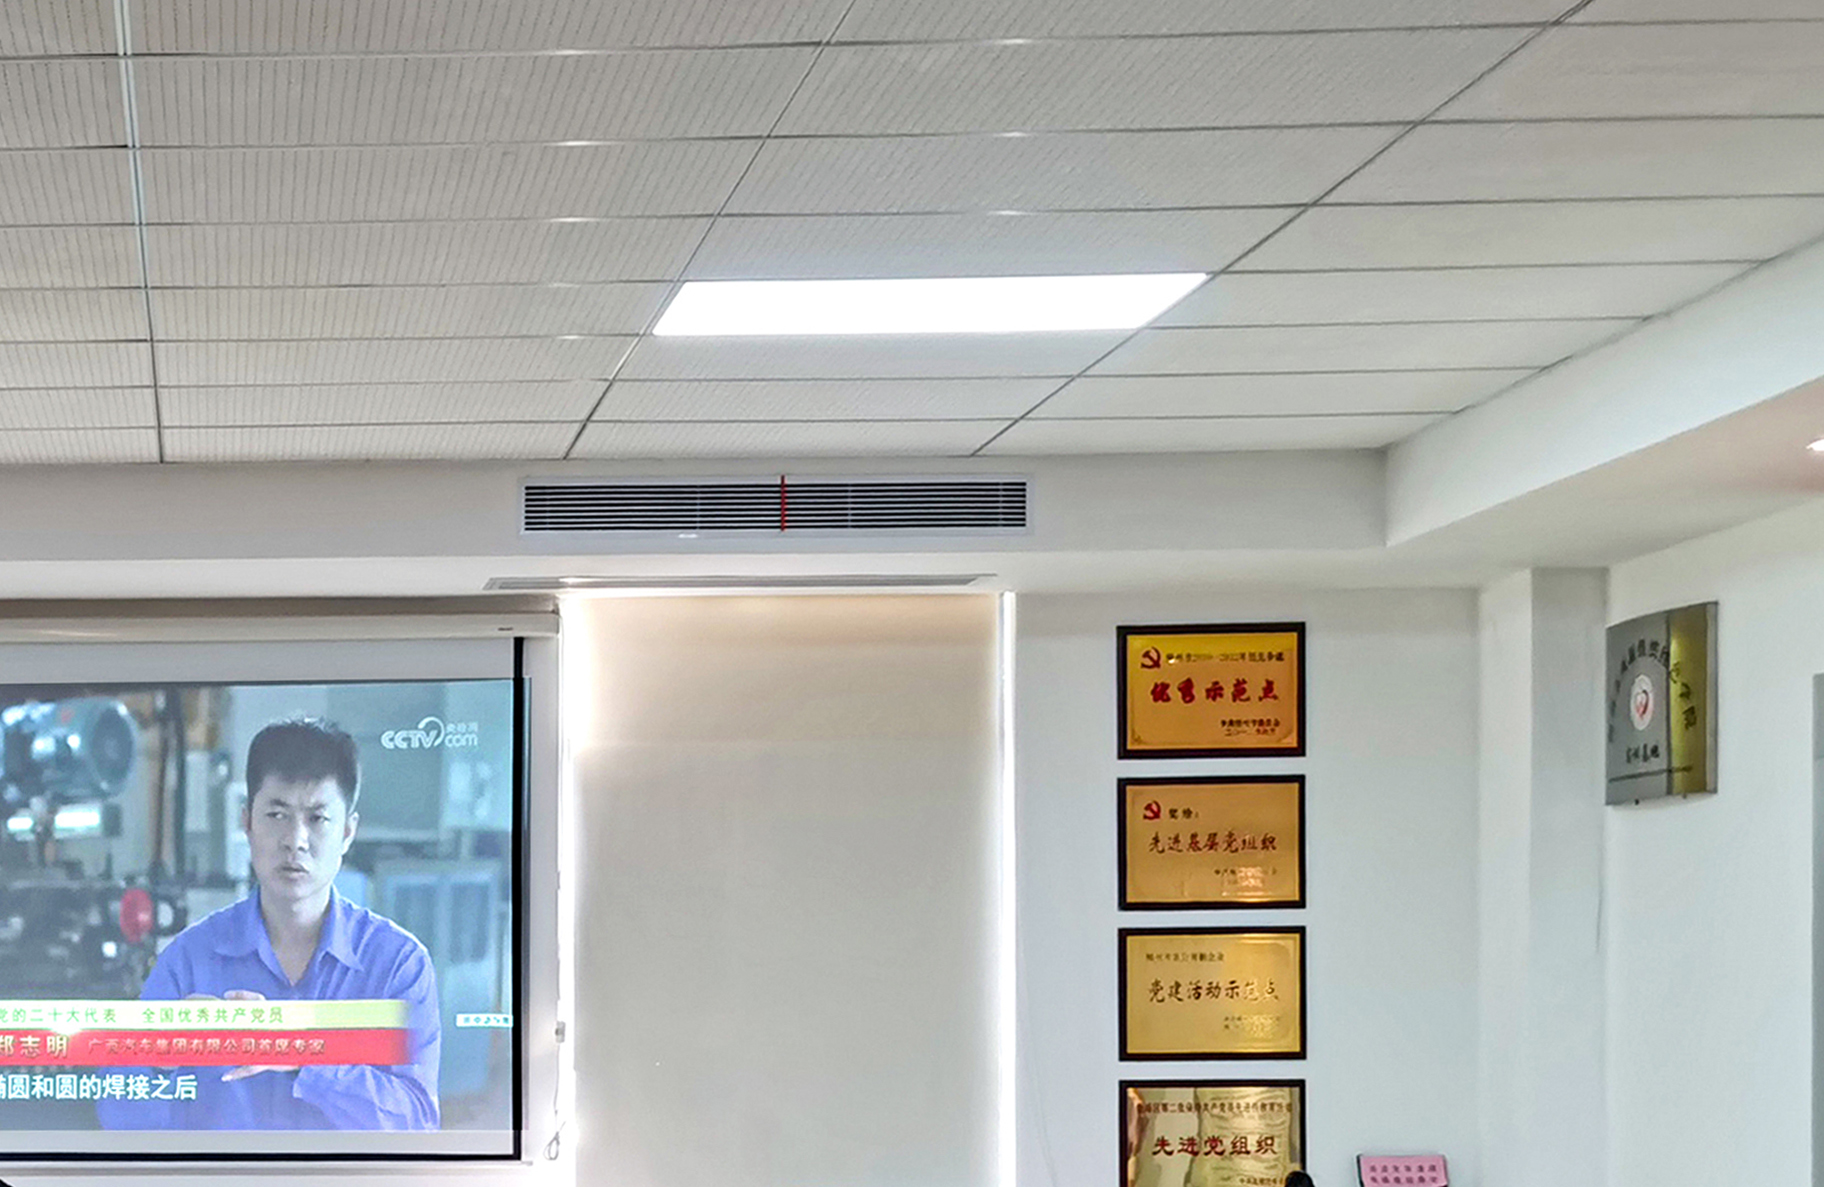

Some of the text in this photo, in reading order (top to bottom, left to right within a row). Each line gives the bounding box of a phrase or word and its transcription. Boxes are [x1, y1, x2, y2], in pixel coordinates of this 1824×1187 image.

[1150, 677, 1279, 704] 优秀示范点
[380, 729, 438, 750] CCTV
[1148, 830, 1278, 854] 先进基层党组织
[1147, 978, 1280, 1004] 党建活动示范点
[141, 1006, 284, 1024] 全国优秀共产党员
[1151, 1134, 1278, 1157] 先进党组织
